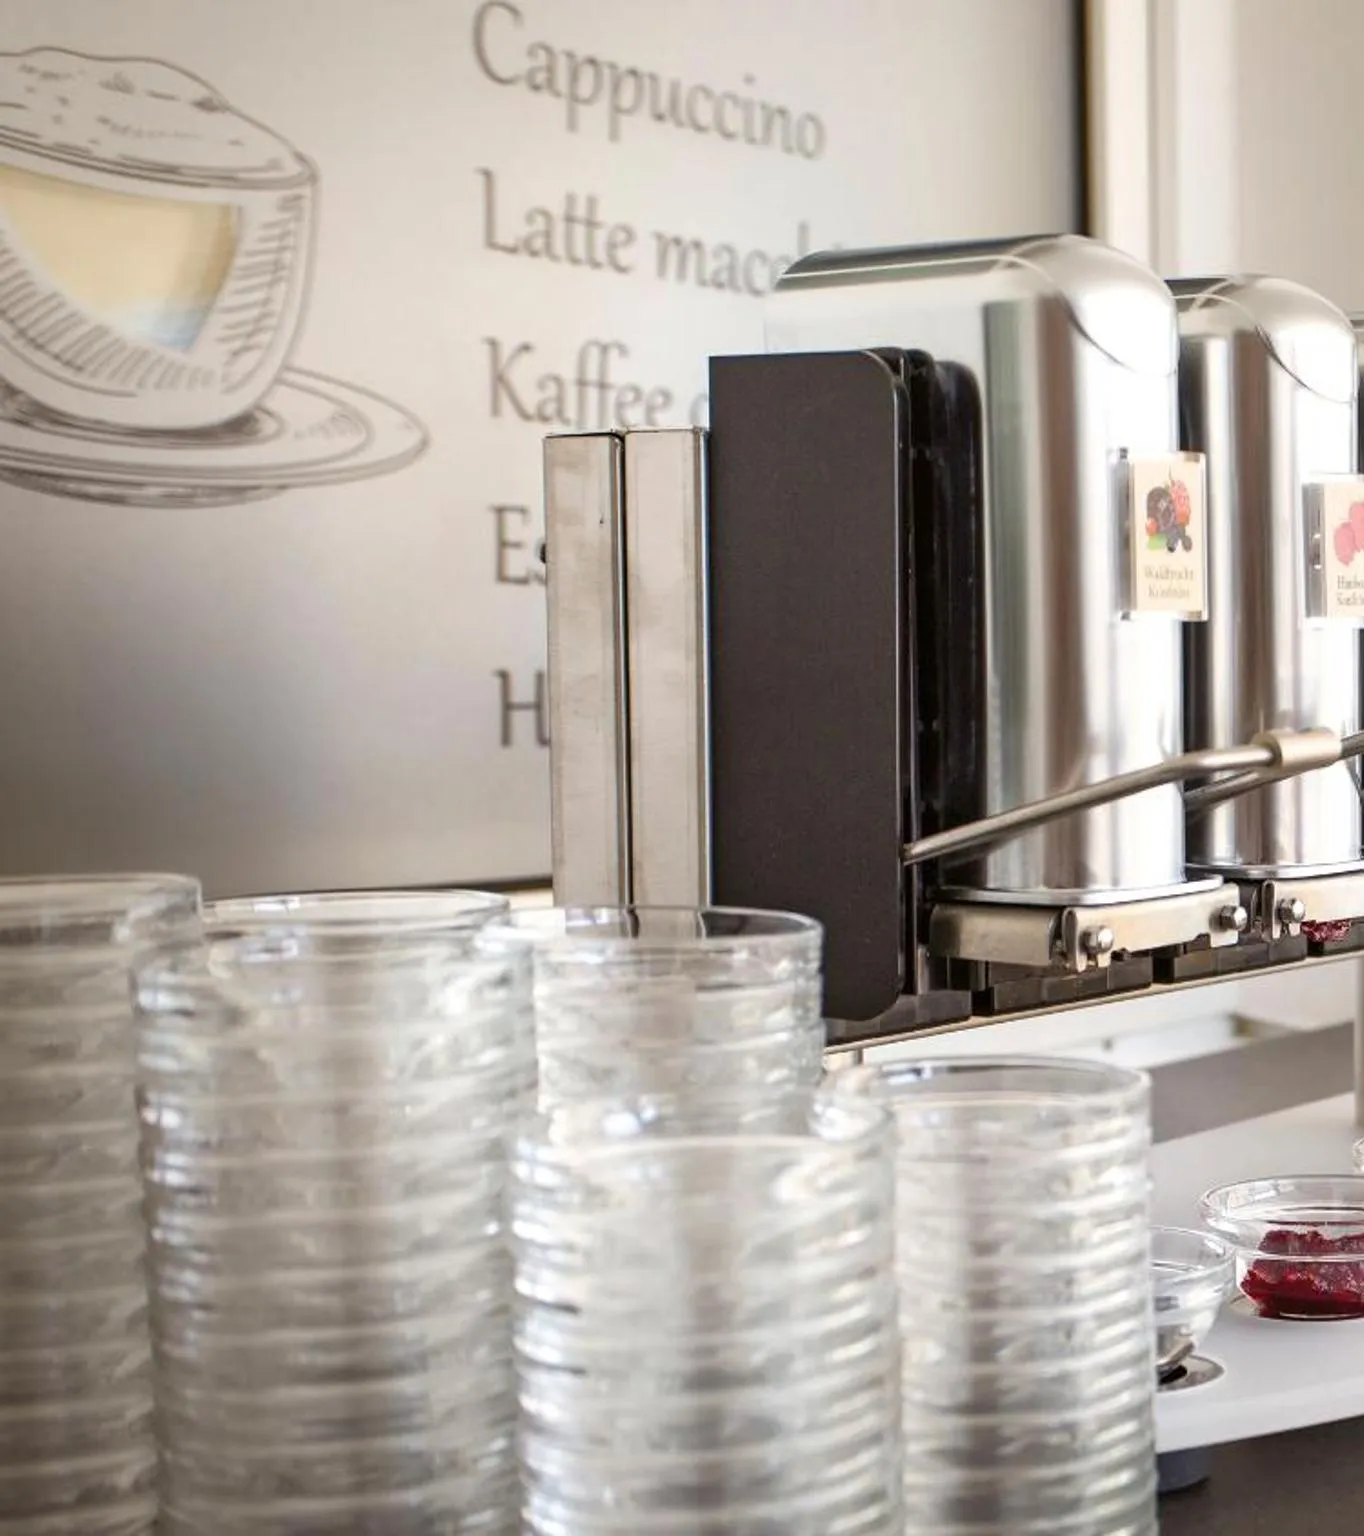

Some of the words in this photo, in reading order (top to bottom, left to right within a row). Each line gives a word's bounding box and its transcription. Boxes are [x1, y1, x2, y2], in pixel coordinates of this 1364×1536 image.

[473, 0, 828, 160] Cappuccino
[475, 166, 638, 274] Latte
[482, 336, 675, 428] Kaffee
